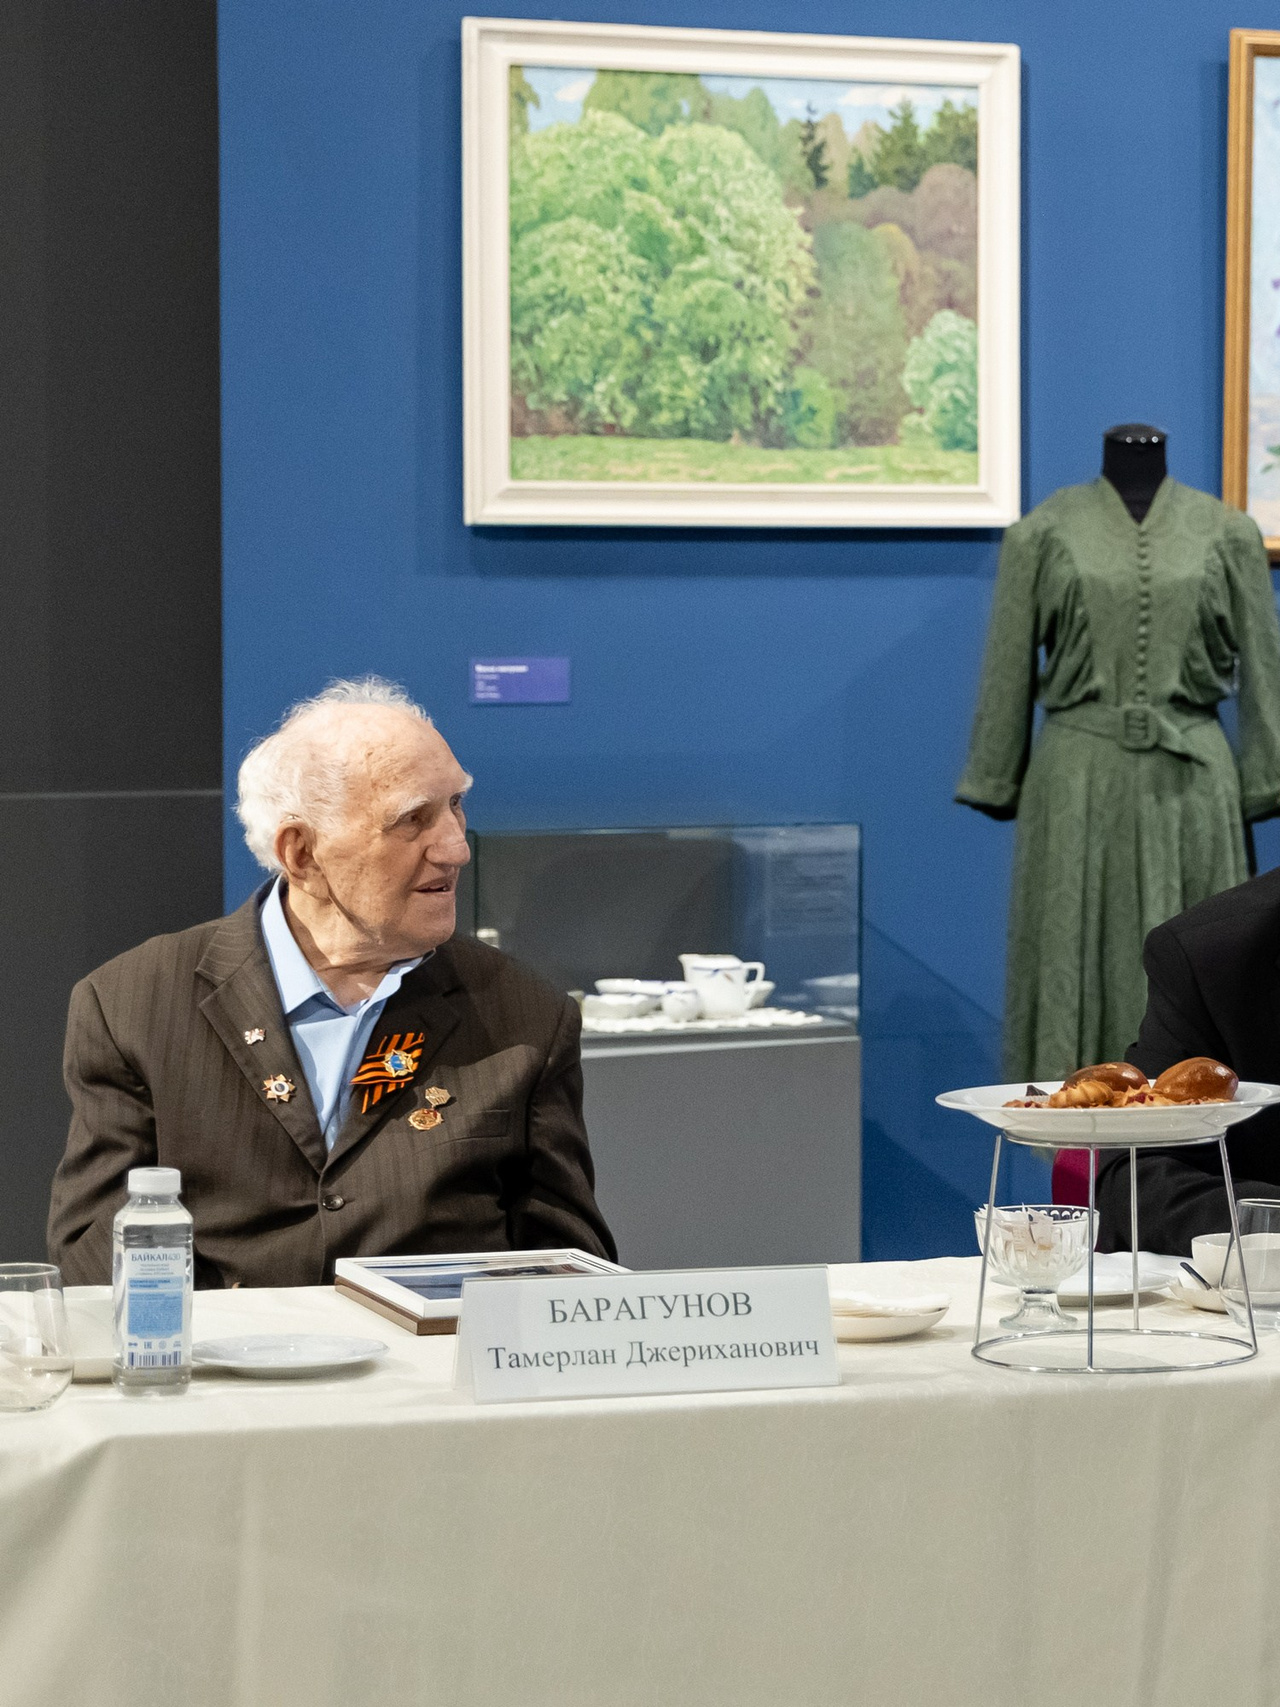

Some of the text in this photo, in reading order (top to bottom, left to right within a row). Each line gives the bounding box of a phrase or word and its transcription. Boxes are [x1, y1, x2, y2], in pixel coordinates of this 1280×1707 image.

[548, 1291, 752, 1324] БАРАГУНОВ
[487, 1340, 820, 1373] Тамерлан Джериханович
